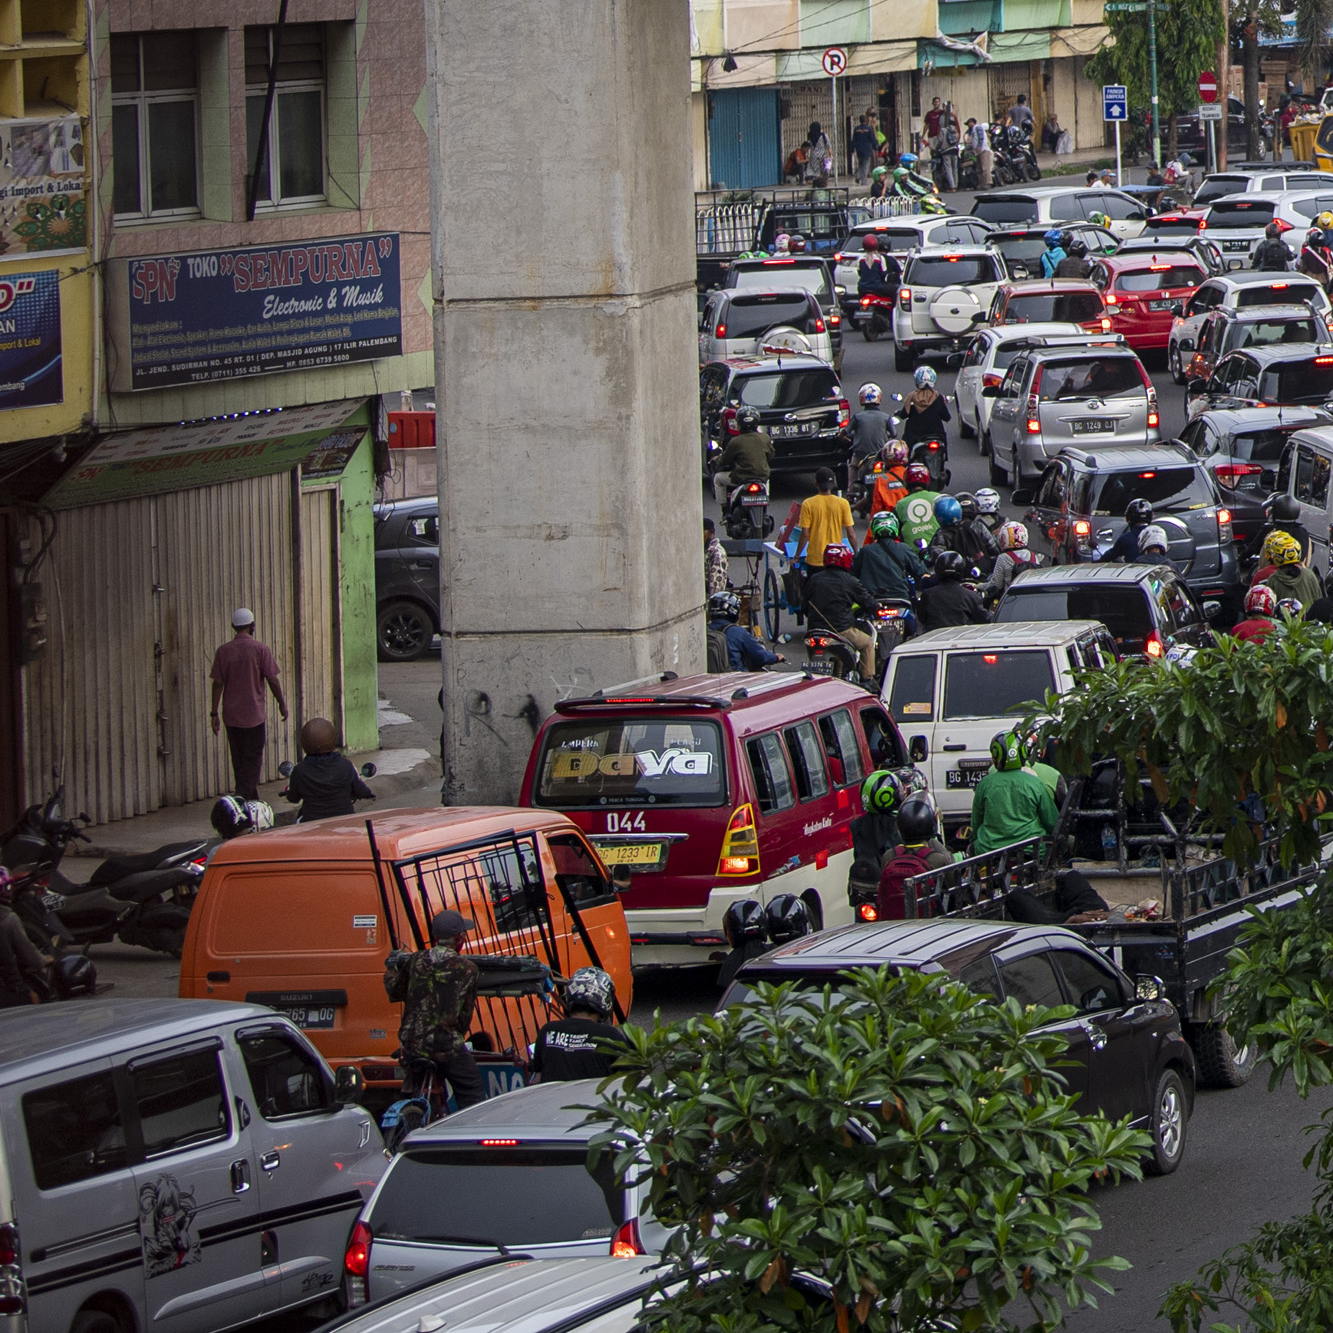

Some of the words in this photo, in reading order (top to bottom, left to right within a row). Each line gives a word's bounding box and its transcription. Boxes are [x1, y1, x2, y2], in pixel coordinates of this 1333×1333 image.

[10, 184, 44, 198] Import
[46, 184, 54, 194] &
[188, 256, 218, 278] TOKO
[262, 294, 324, 319] Electronic
[327, 288, 337, 309] &
[341, 282, 384, 308] Musik
[0, 340, 16, 351] mport
[24, 337, 42, 348] Lokal
[136, 368, 146, 376] JL.
[149, 365, 170, 375] JEND.
[172, 360, 208, 372] SUDIRMAN
[210, 358, 222, 367] NO.
[234, 356, 244, 364] RT.
[246, 354, 255, 362] 01
[261, 352, 276, 360] DEP.
[277, 348, 303, 358] MASJID
[304, 345, 328, 356] AGUNG
[334, 342, 342, 350] 17
[343, 341, 358, 350] ILIR
[358, 336, 398, 348] PALEMBANG
[192, 371, 210, 380] TELP.
[286, 360, 297, 368] HP.
[0, 380, 26, 393] embang
[772, 426, 780, 434] BG
[1074, 422, 1082, 430] BG
[1086, 422, 1101, 430] 1249
[912, 524, 934, 534] gojek
[949, 772, 960, 783] BG
[606, 811, 646, 832] 044
[616, 846, 640, 858] 1233
[646, 846, 658, 856] IR
[546, 1031, 554, 1044] WE
[555, 1032, 568, 1046] ARE
